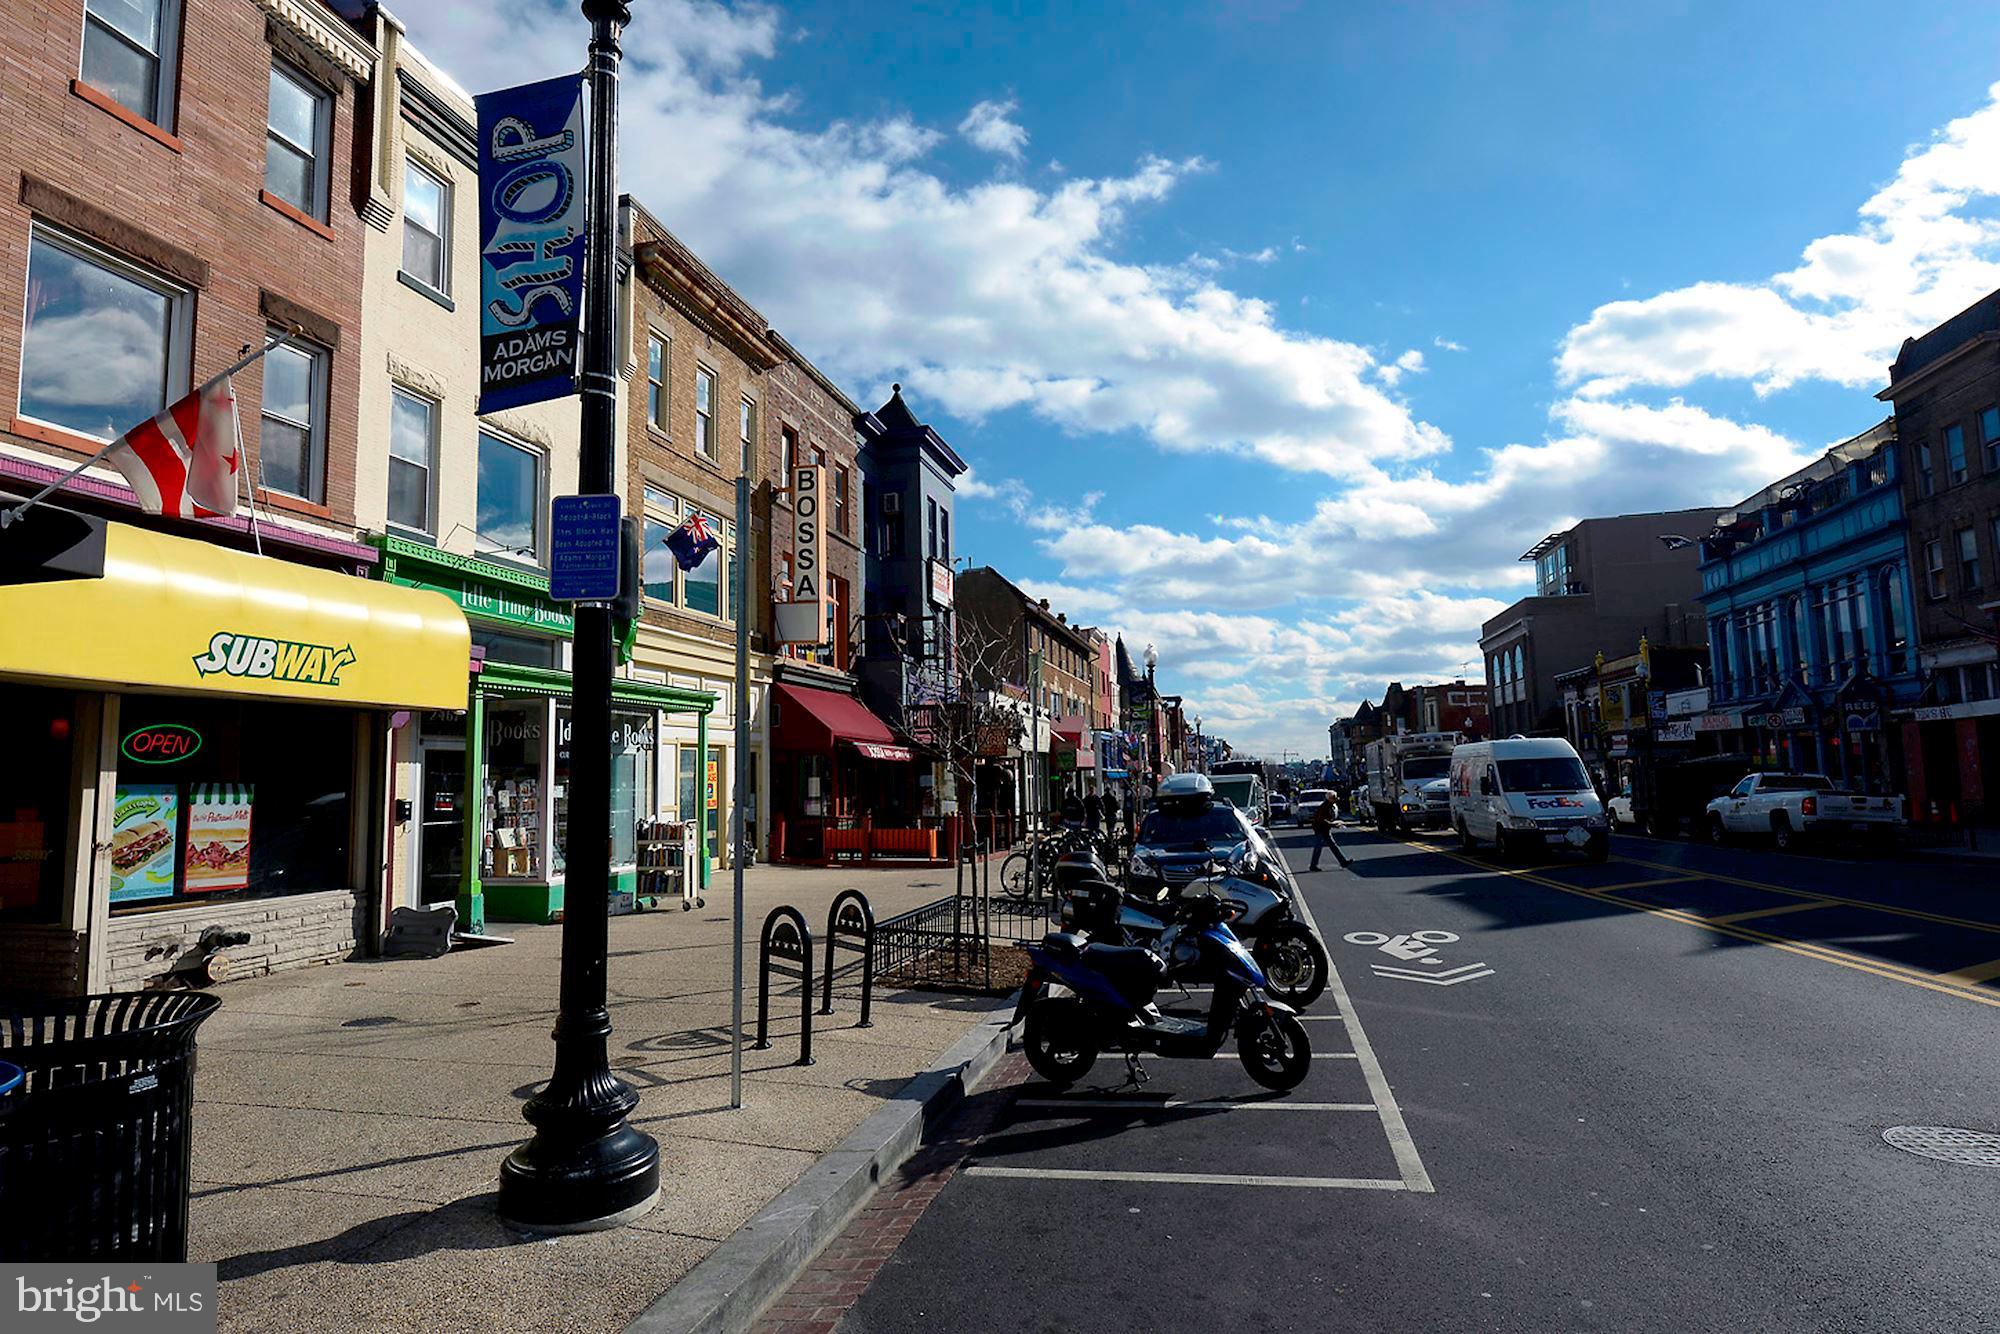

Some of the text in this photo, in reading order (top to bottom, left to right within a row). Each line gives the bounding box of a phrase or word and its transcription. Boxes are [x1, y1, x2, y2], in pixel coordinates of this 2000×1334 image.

[488, 116, 575, 327] SHOP
[493, 330, 567, 361] ADAMS
[483, 347, 573, 383] MORGAN
[575, 539, 603, 548] Adopted
[601, 527, 615, 535] Has
[796, 469, 816, 597] BOSSA
[585, 553, 610, 562] Morgan
[461, 580, 572, 625] Idle Time Books
[193, 632, 356, 686] SUBWAY
[1844, 701, 1880, 712] REEF
[133, 733, 190, 754] OPEN
[1526, 797, 1584, 810] FedEx
